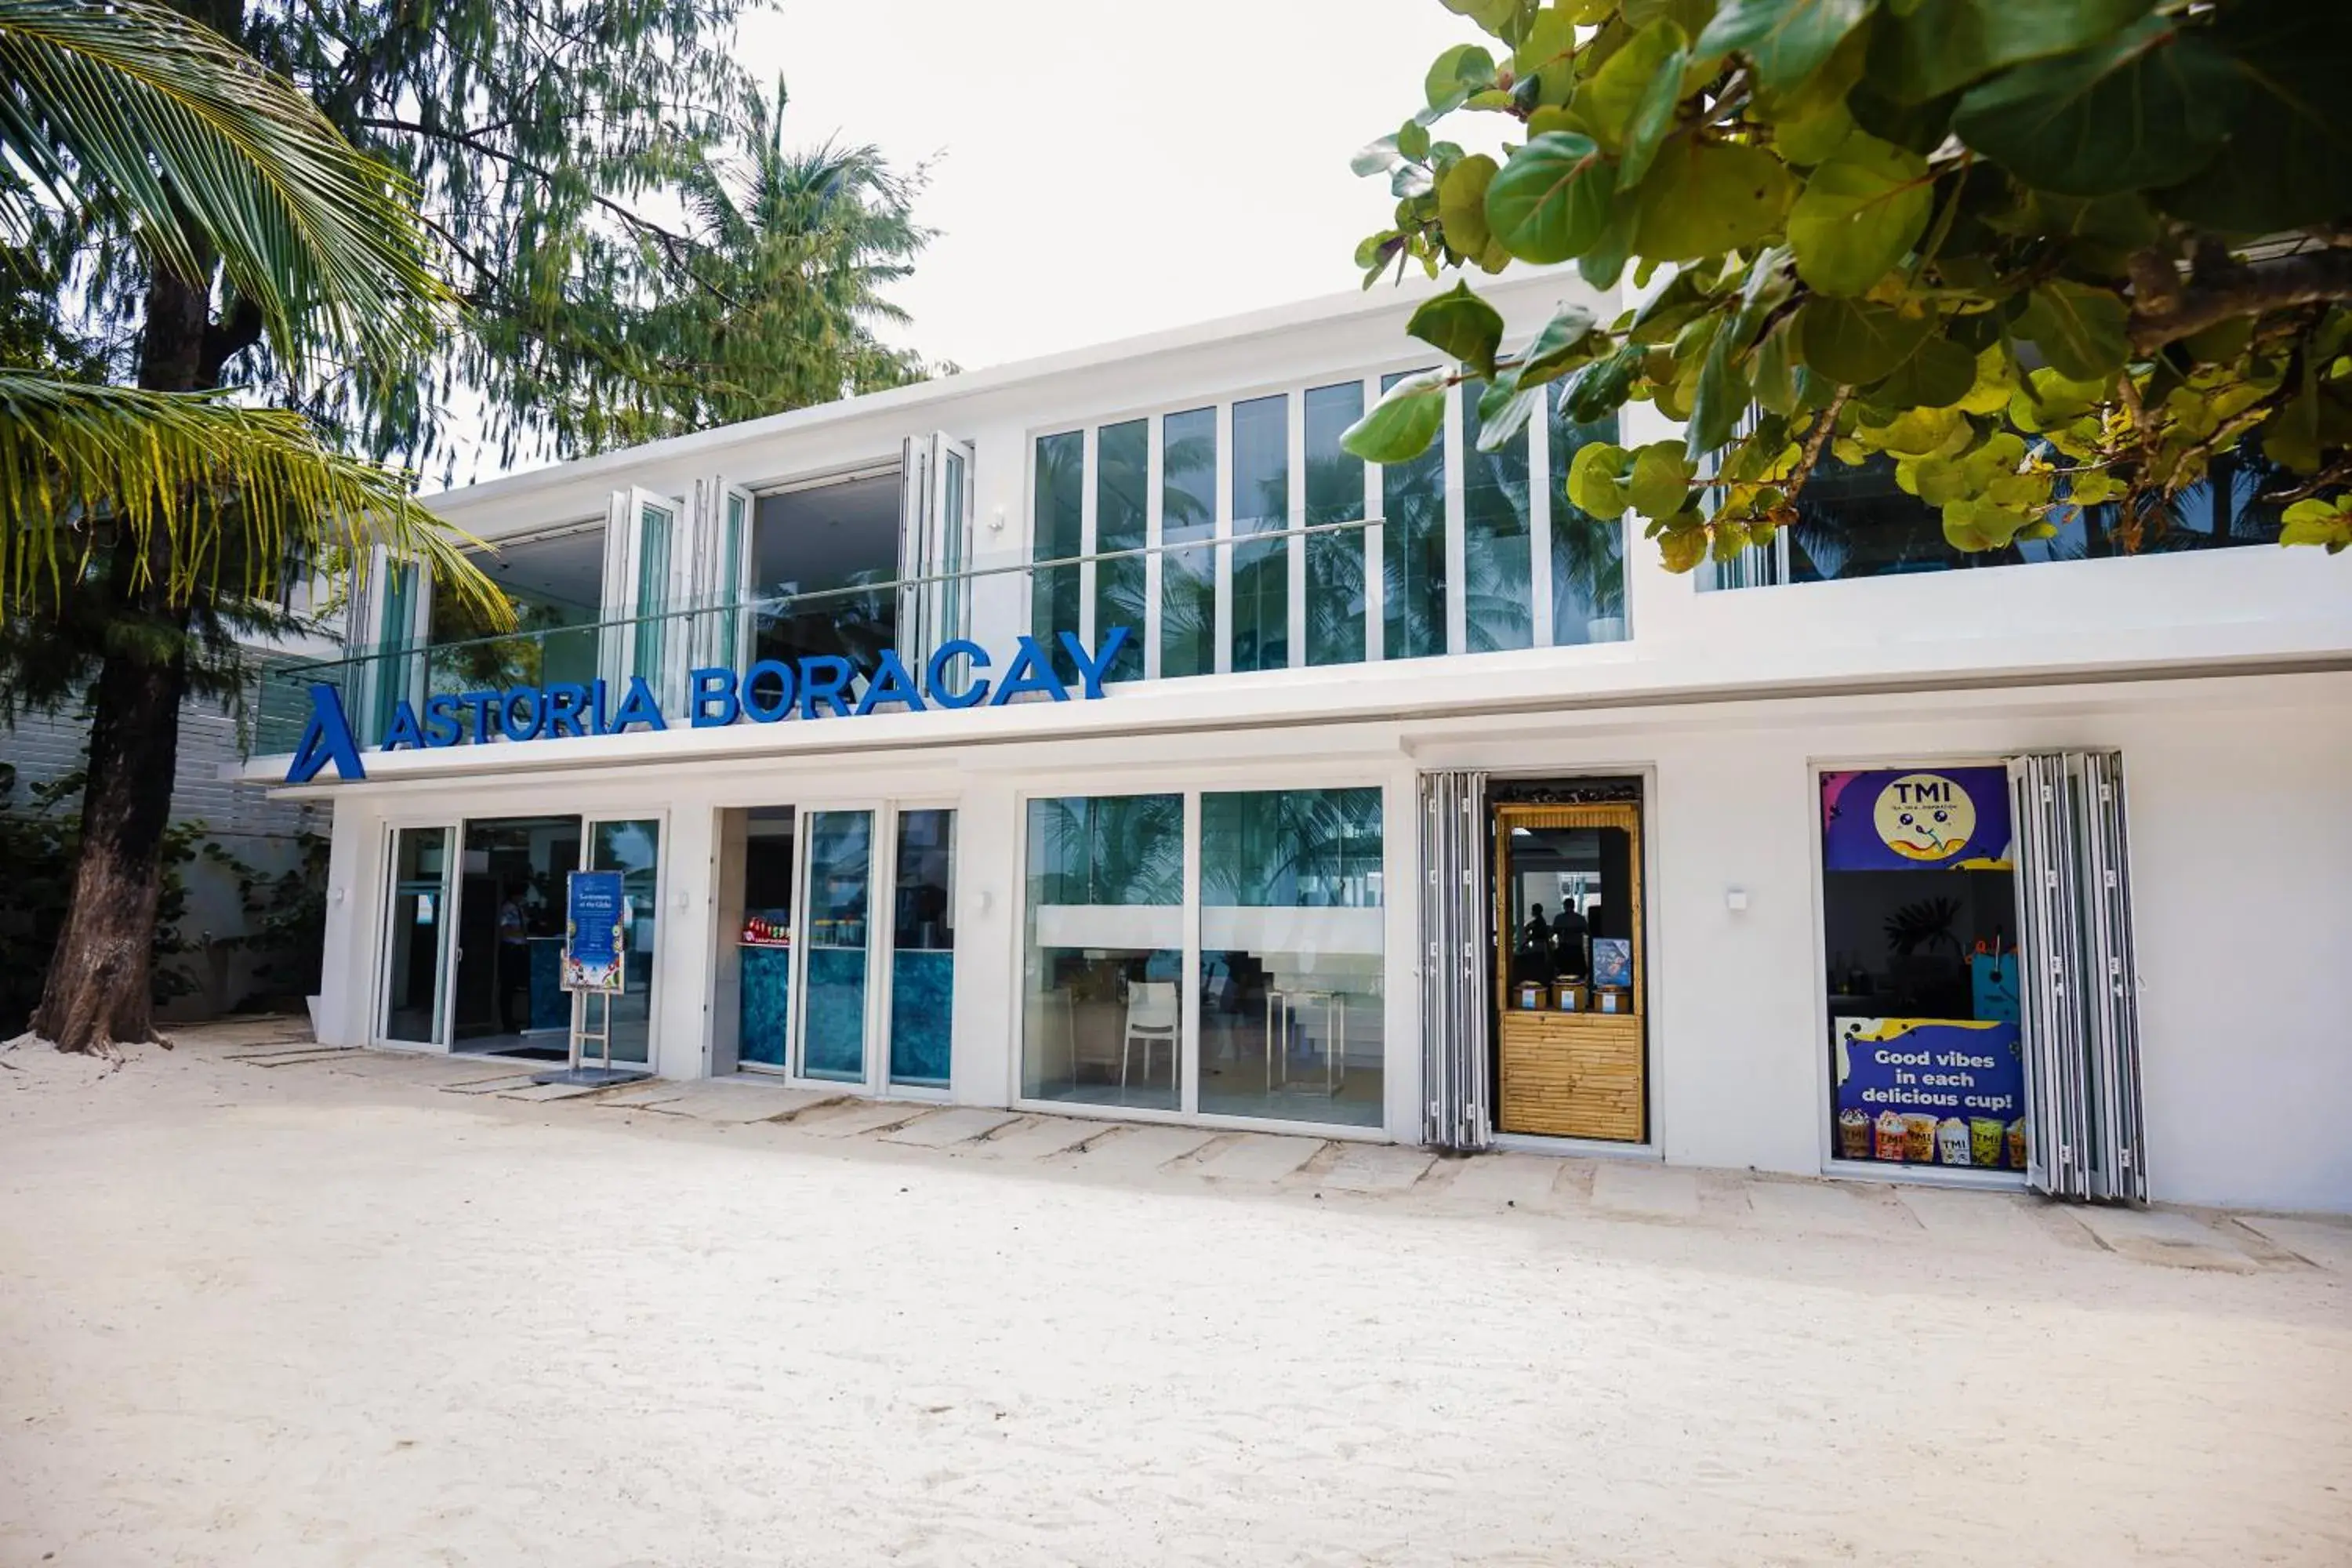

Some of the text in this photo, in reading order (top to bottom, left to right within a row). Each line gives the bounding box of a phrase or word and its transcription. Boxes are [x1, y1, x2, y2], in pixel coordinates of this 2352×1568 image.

[381, 626, 1133, 752] ASTORIA BORACAY
[1893, 782, 1951, 804] TMI
[1875, 1049, 1995, 1068] Good vibes
[1895, 1068, 1974, 1087] in each
[1861, 1087, 2013, 1112] delicious cup!
[1943, 1139, 1966, 1149] TMI
[1973, 1133, 1998, 1144] TMI
